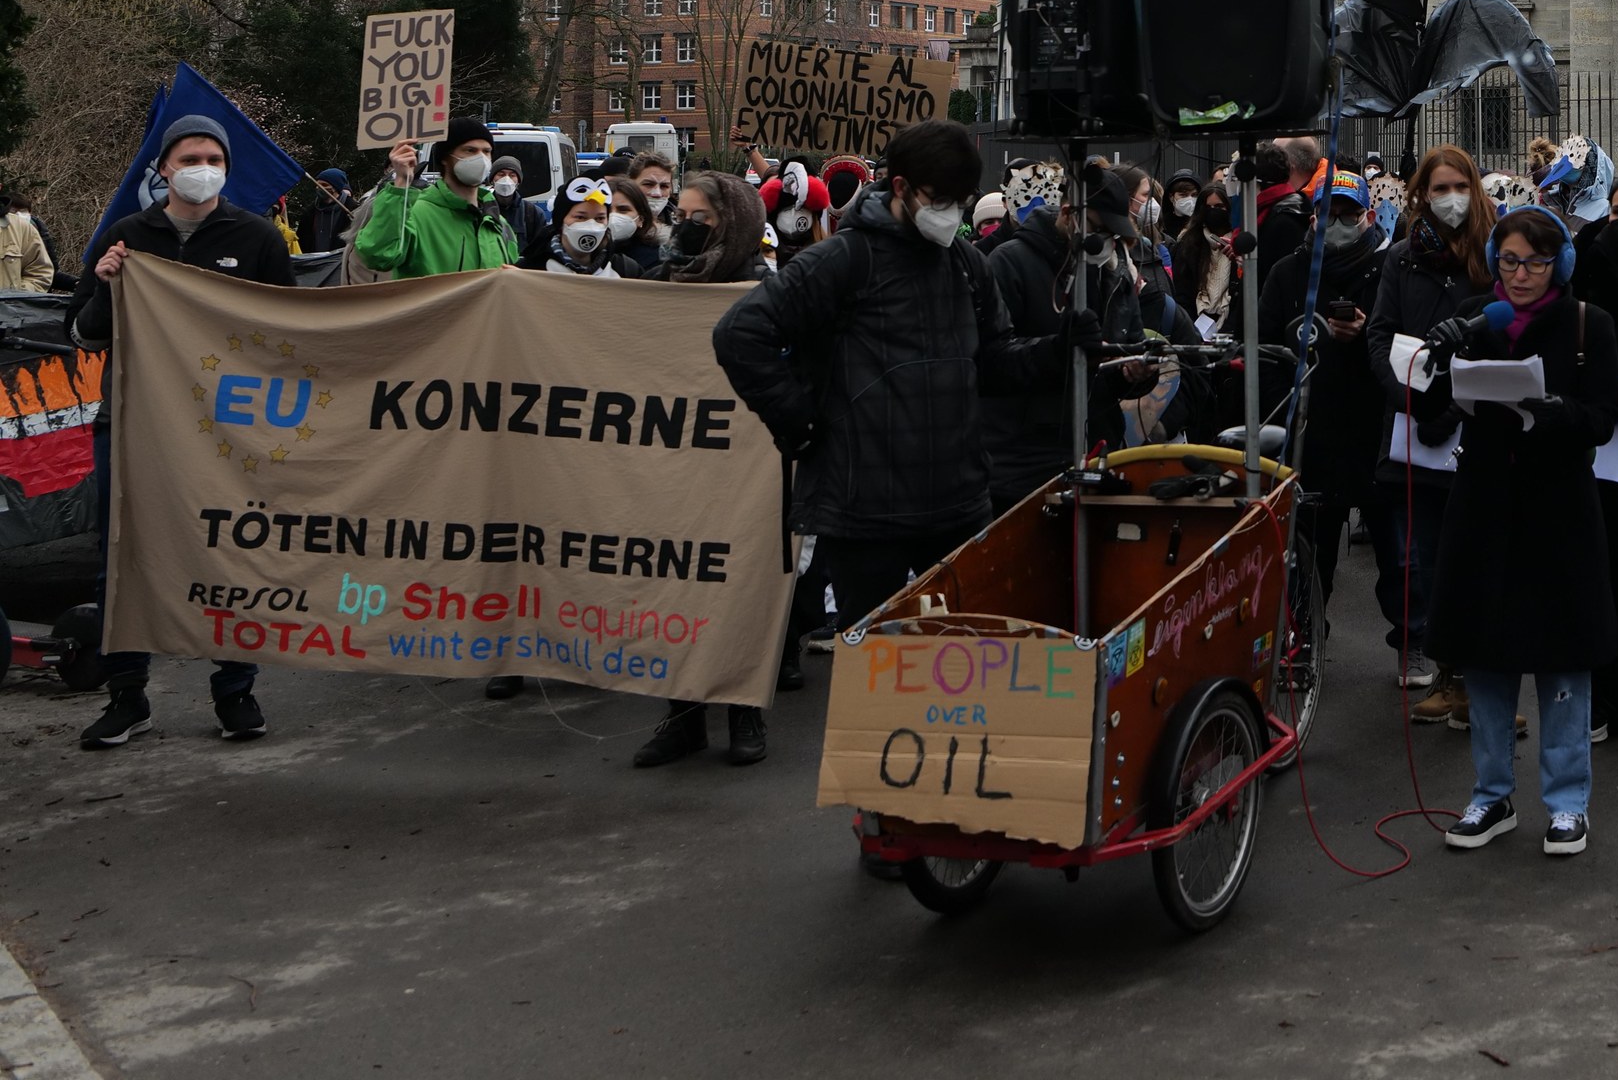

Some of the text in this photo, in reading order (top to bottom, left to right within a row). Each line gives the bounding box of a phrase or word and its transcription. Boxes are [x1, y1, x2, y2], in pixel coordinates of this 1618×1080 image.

[370, 13, 453, 49] FUCK
[367, 48, 445, 84] YOU
[749, 41, 927, 89] MUERTE AL
[745, 76, 935, 120] COLONIALISMO
[737, 107, 900, 157] EXTRACTIVIS
[214, 374, 736, 450] EU KONZERNE
[200, 500, 730, 583] TÖTEN IN DER FERNE
[187, 572, 709, 645] REPSOL bp Shell equinor
[203, 608, 669, 680] TOTAL wintershall dea
[861, 638, 1076, 699] PEOPLE
[926, 704, 987, 726] OVER
[880, 727, 1013, 800] OIL
